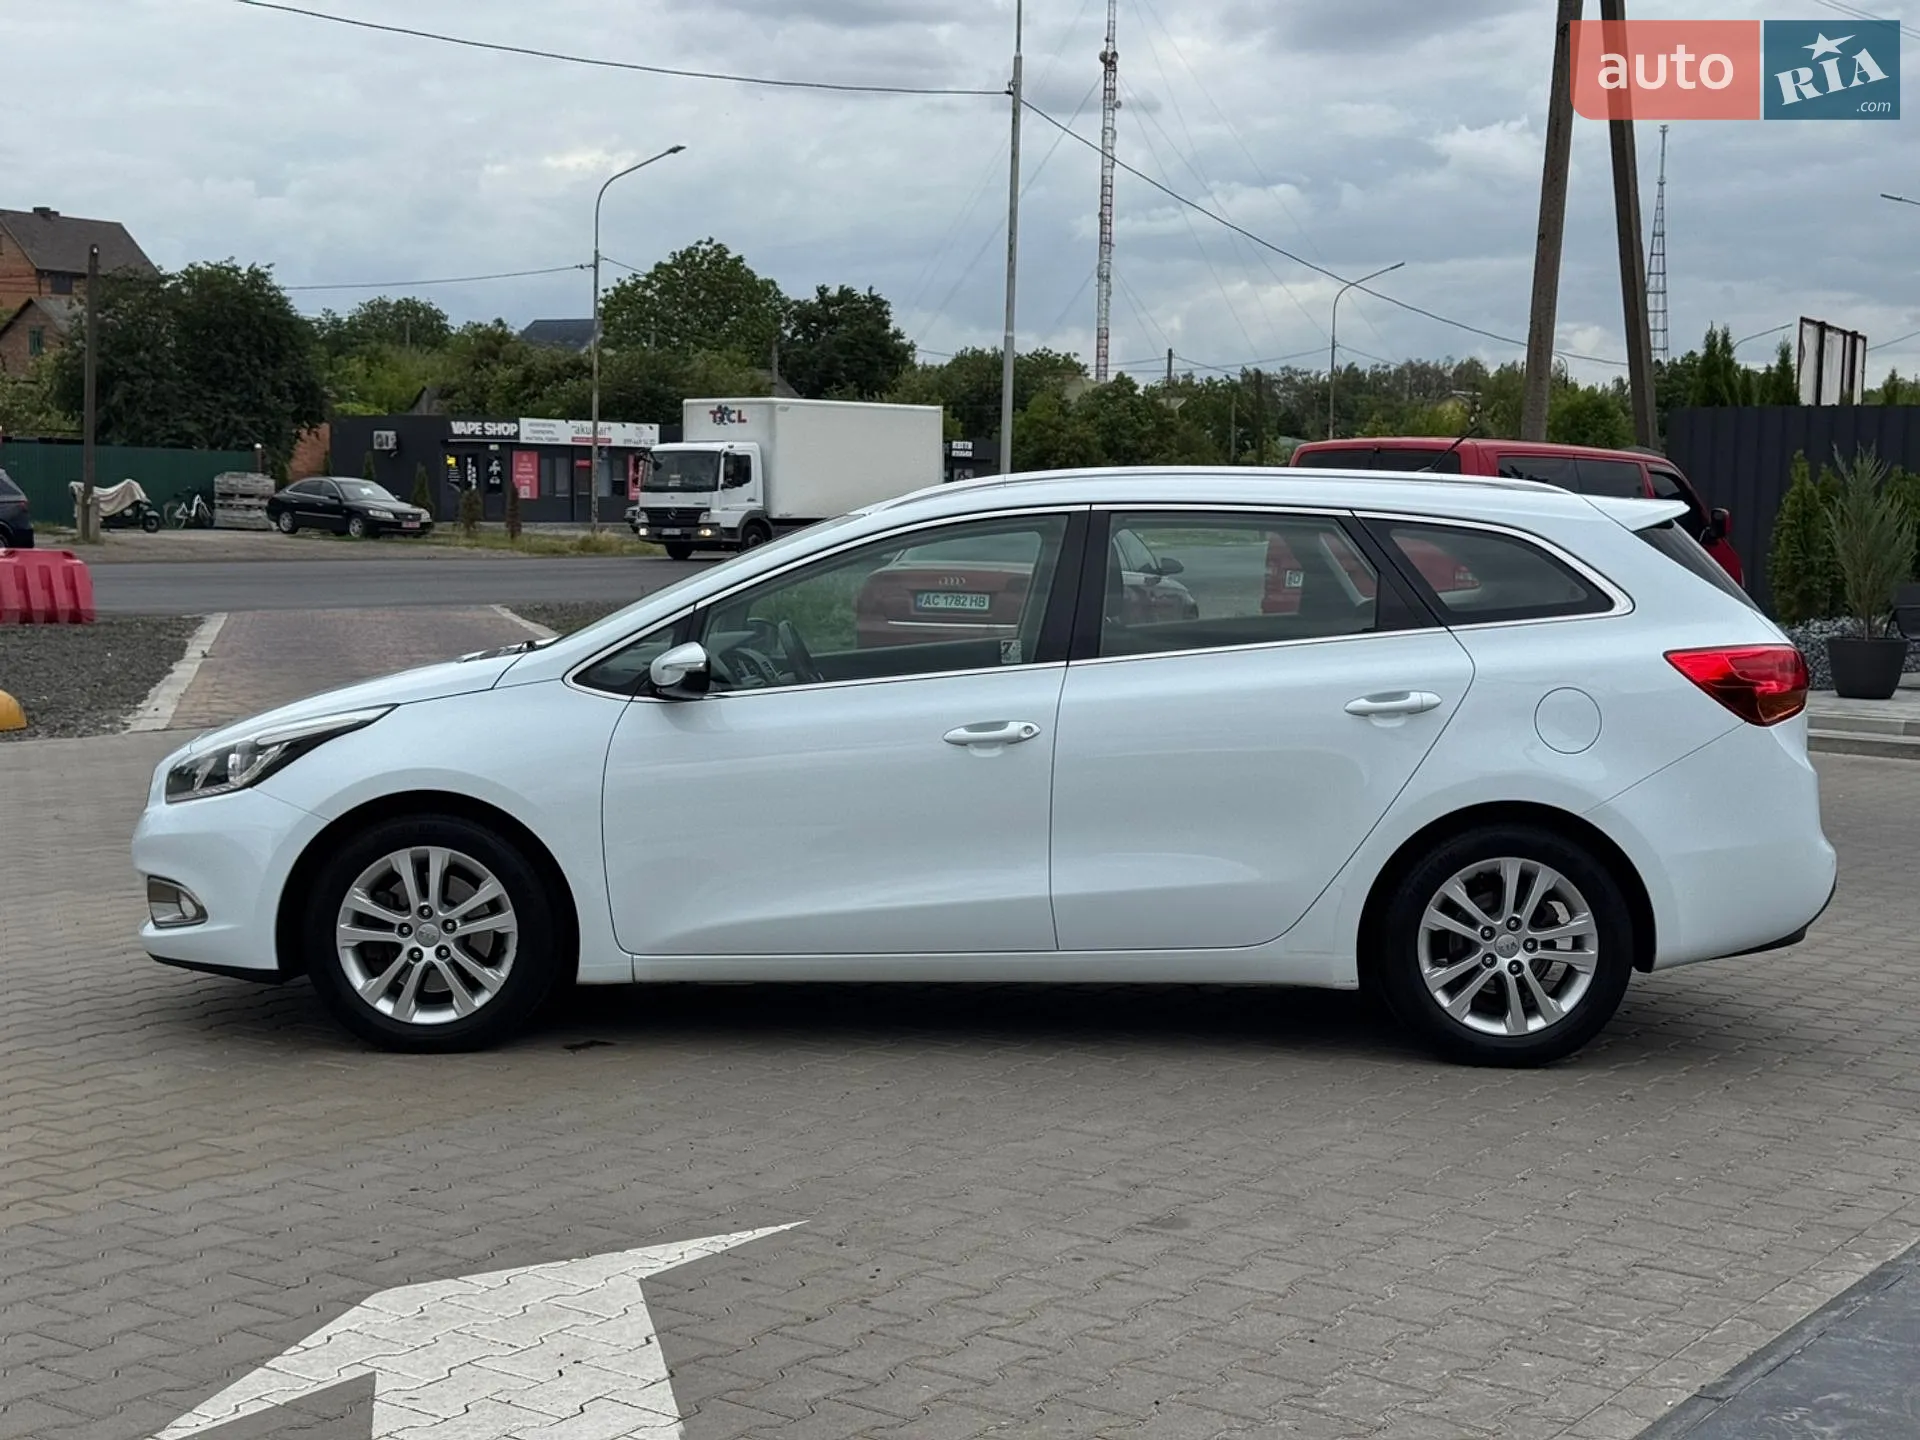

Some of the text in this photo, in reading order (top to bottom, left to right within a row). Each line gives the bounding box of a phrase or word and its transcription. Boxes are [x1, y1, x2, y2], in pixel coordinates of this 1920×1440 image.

[451, 421, 482, 435] VAPE
[484, 422, 518, 436] SHOP
[923, 594, 986, 608] AC 1782 HB
